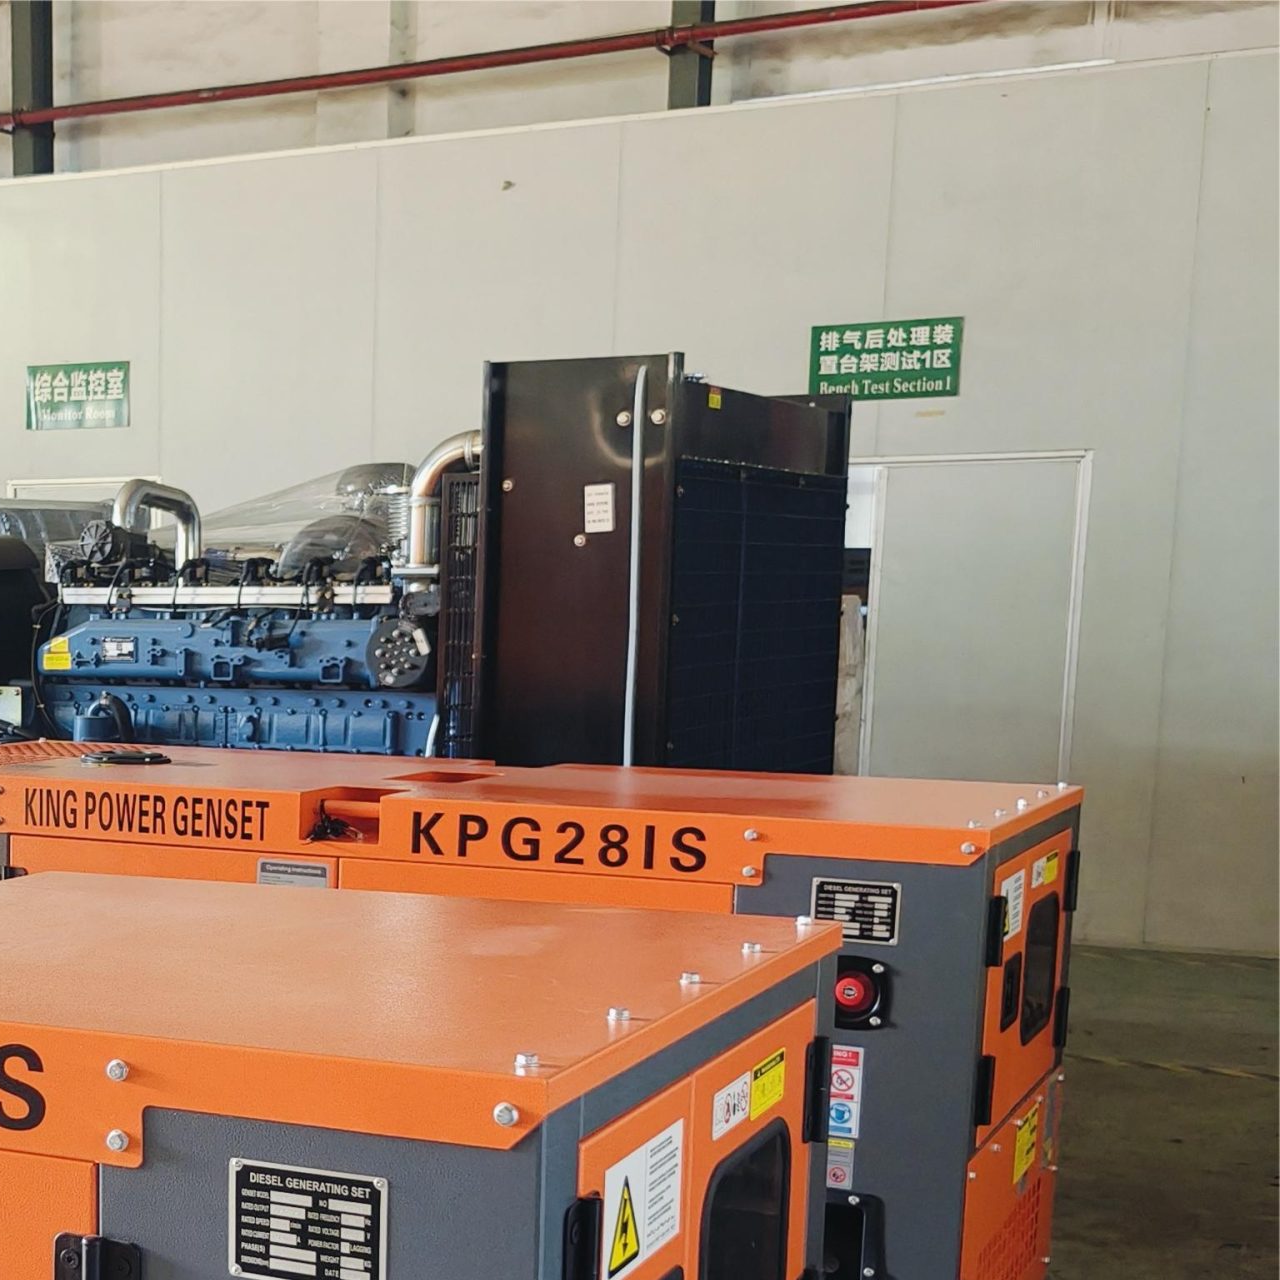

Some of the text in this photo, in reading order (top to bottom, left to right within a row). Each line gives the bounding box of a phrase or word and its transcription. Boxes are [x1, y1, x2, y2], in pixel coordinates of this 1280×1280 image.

[819, 324, 954, 351] 排气后处理装
[818, 349, 952, 375] 置台架测试1区
[35, 367, 124, 403] 综合监控室
[862, 379, 890, 395] Test
[893, 376, 943, 393] Section
[24, 787, 270, 841] KING POWER GENSET
[410, 811, 707, 873] KPG28IS
[249, 1171, 371, 1199] DIESEL GENERATING SET
[324, 1268, 339, 1278] DATE
